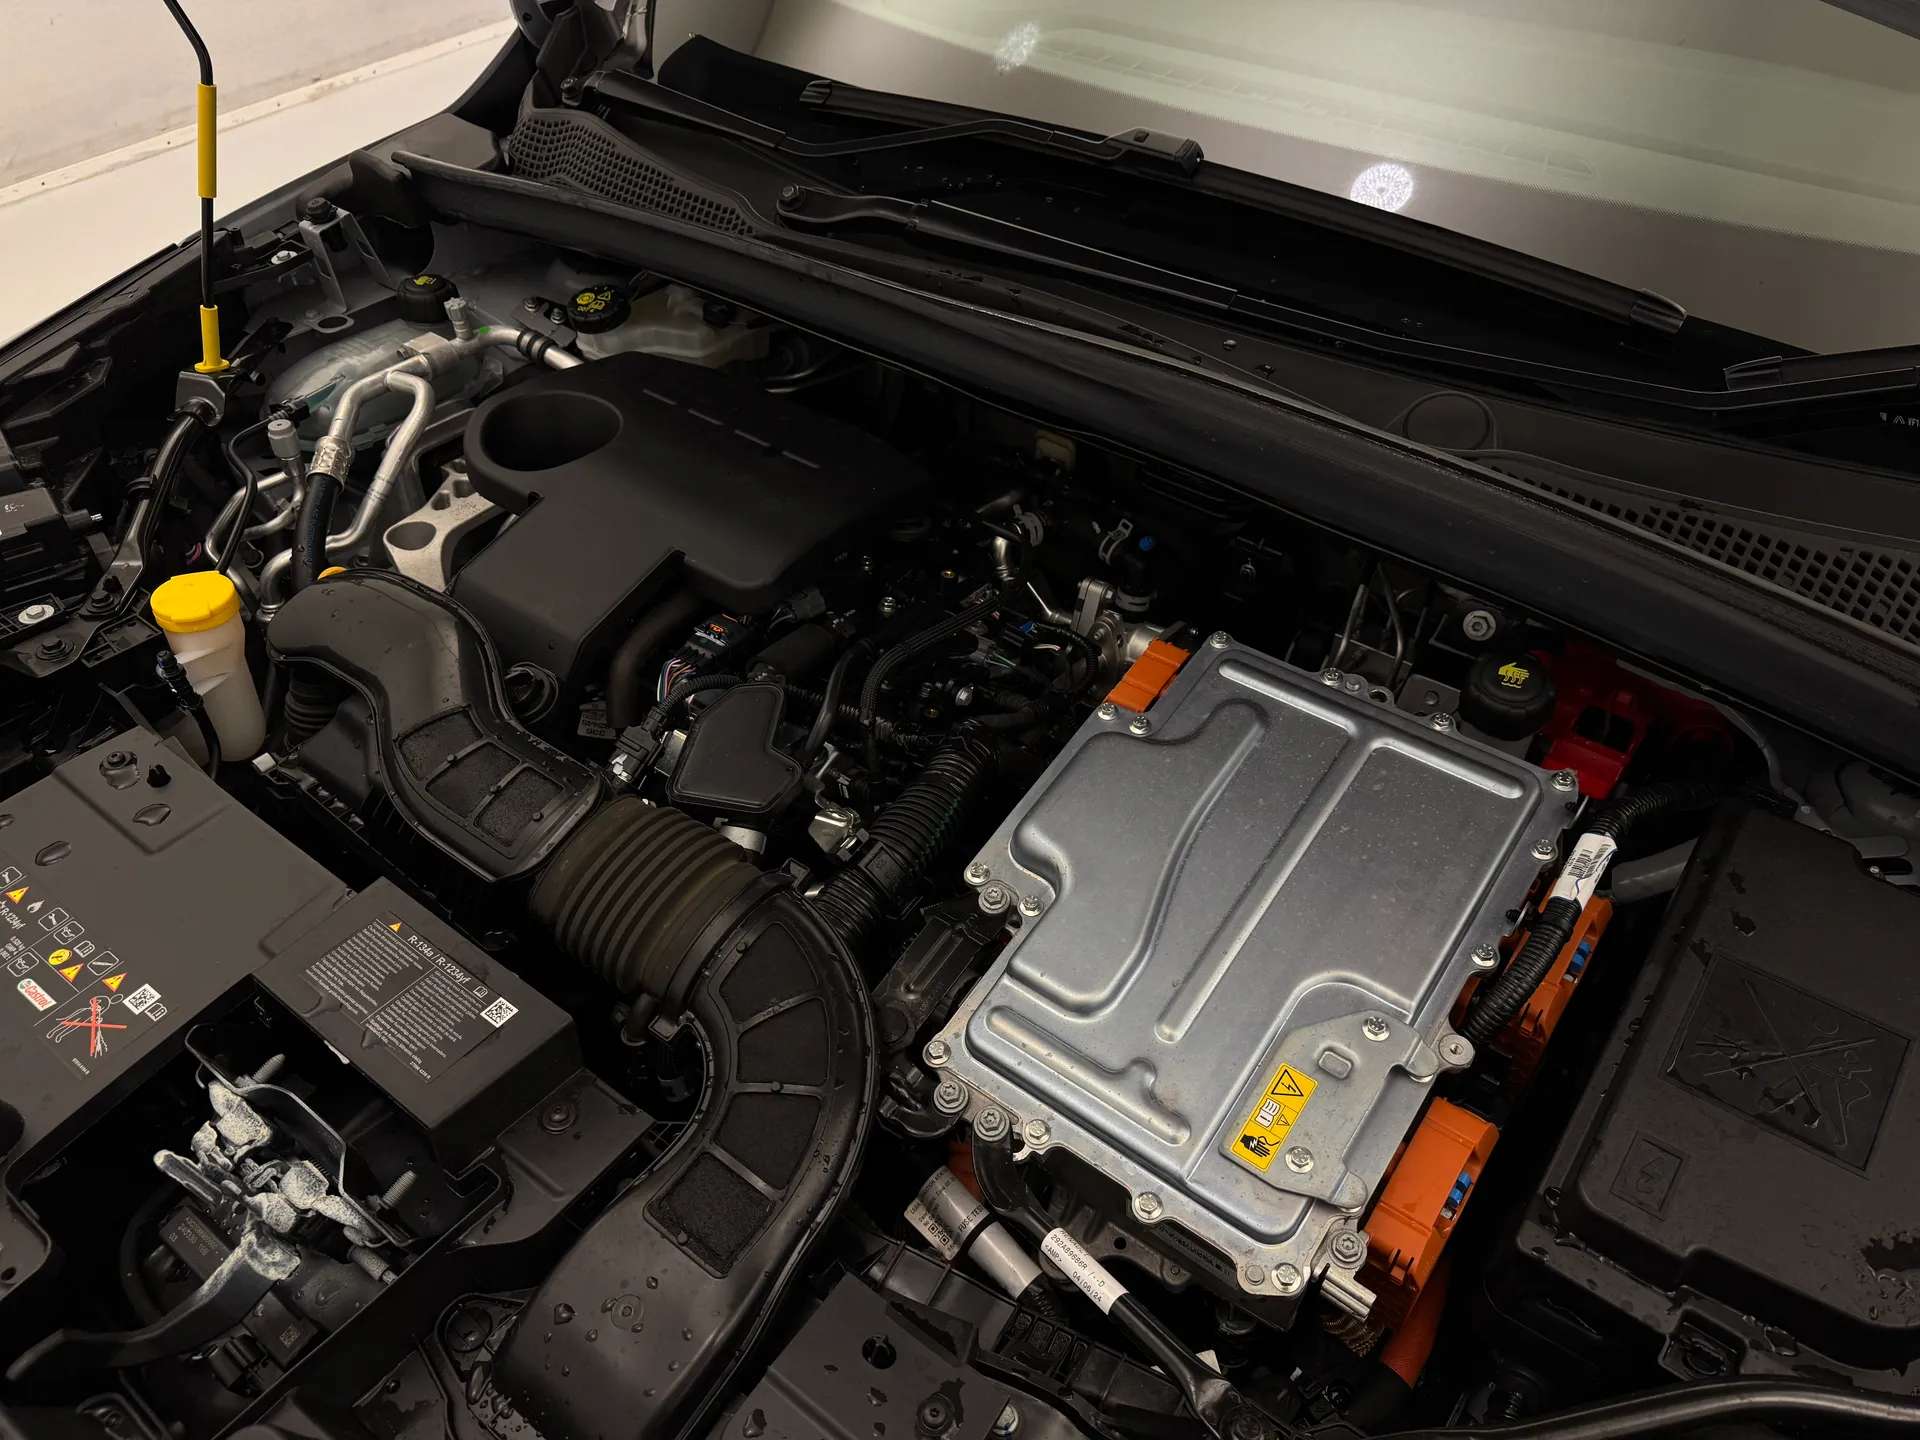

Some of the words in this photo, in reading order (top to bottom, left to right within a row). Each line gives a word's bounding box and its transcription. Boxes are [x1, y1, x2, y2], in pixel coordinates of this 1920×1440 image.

[407, 935, 434, 957] R-134a
[435, 956, 472, 985] R-1234yf
[24, 985, 50, 1009] Castrol
